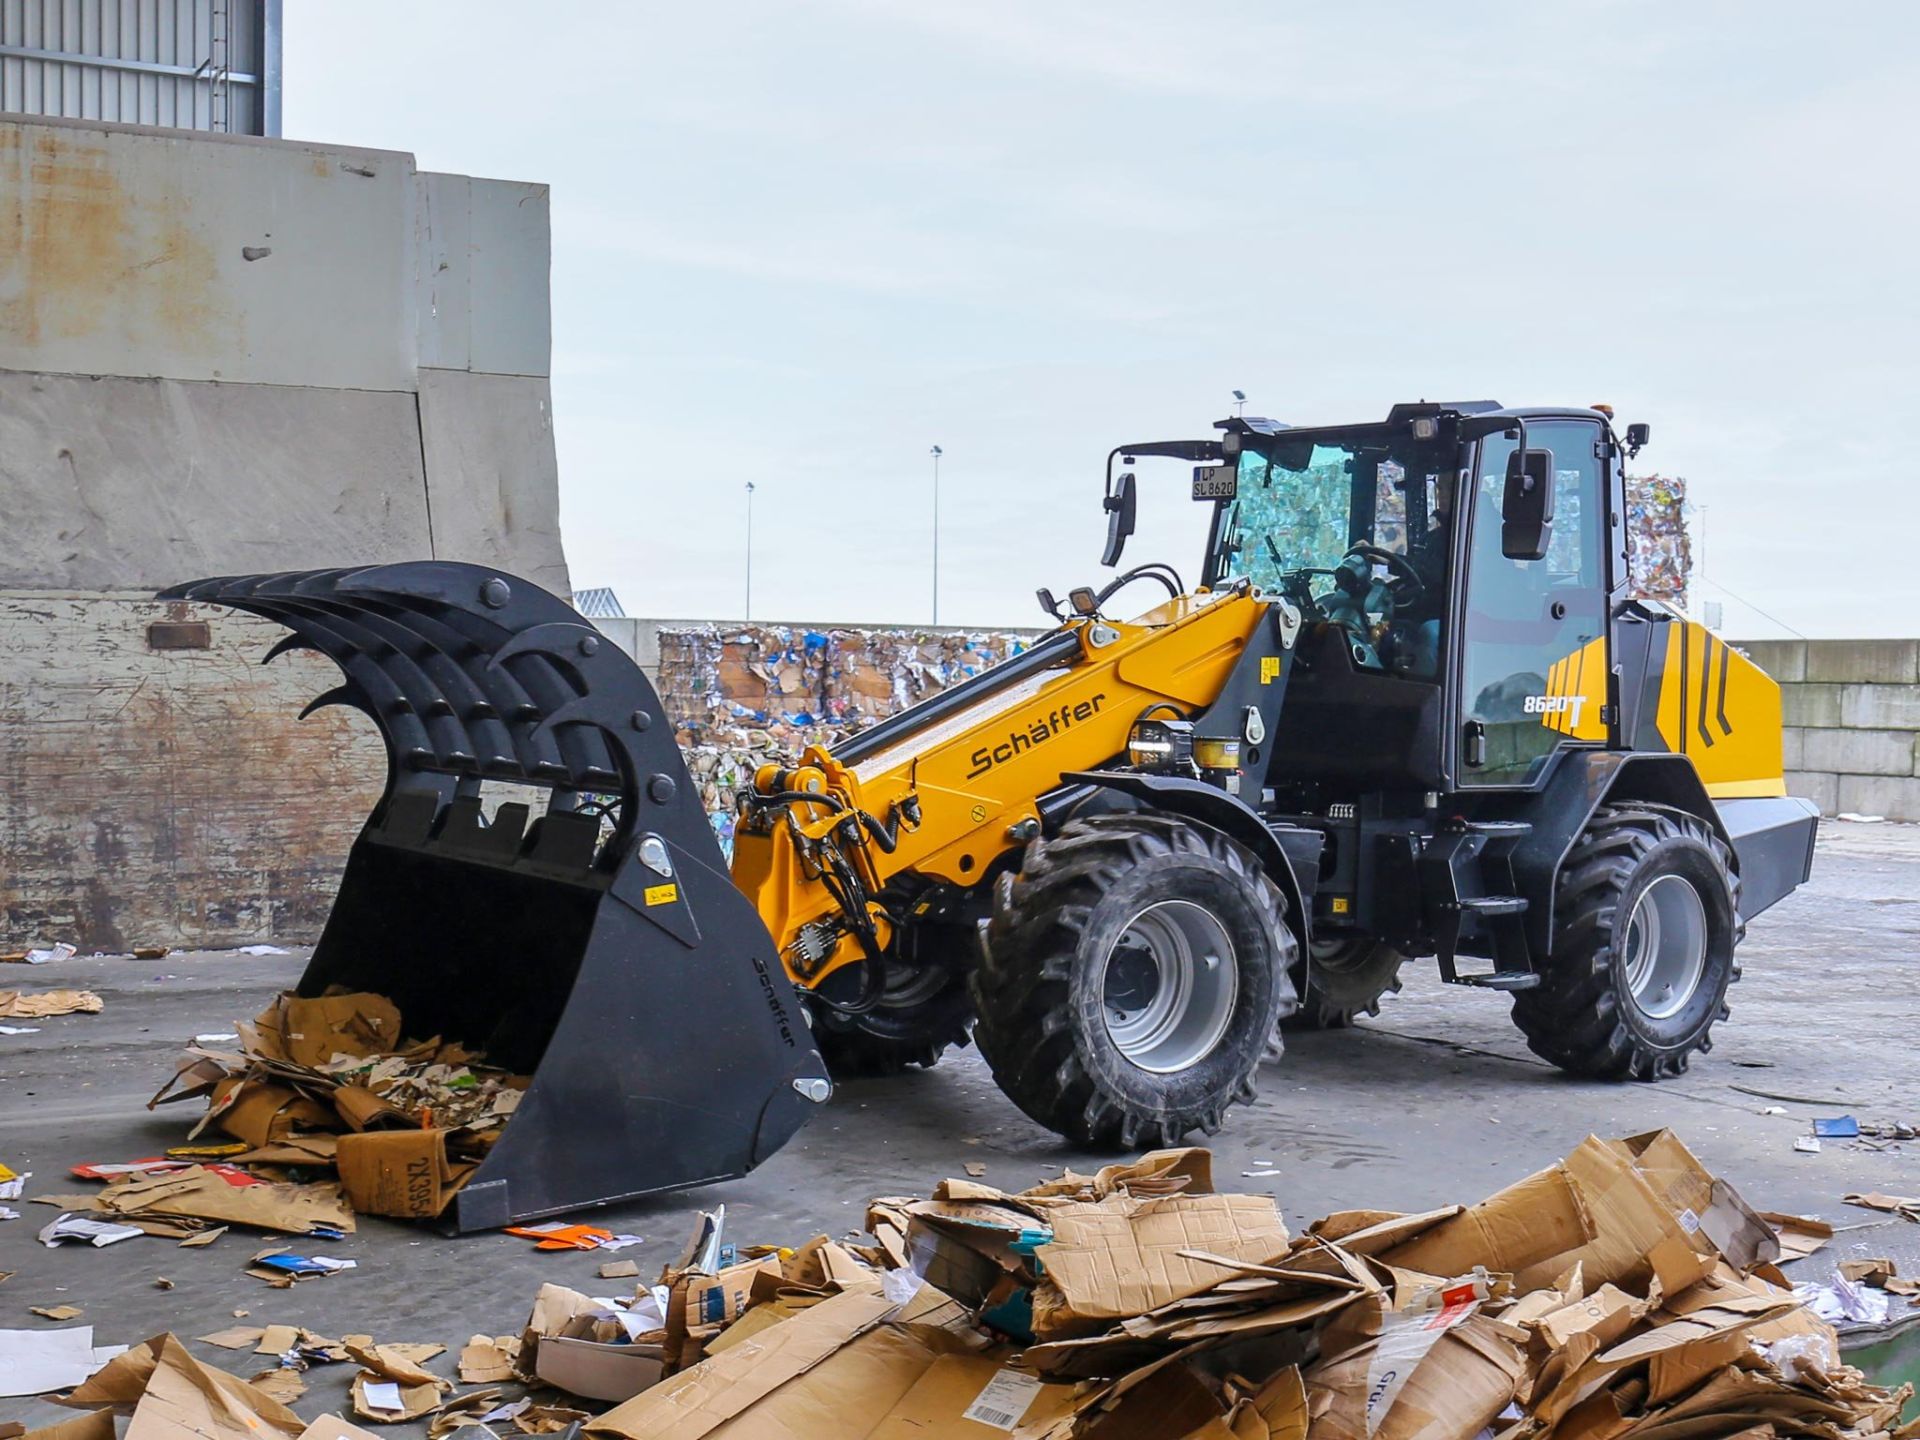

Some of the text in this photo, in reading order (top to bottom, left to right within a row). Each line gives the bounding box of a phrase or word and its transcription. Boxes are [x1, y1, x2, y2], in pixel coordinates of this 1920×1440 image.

[1202, 468, 1215, 481] LP
[1194, 482, 1233, 496] SL 8620
[1523, 695, 1587, 728] 8620T
[966, 693, 1106, 780] Schäffer
